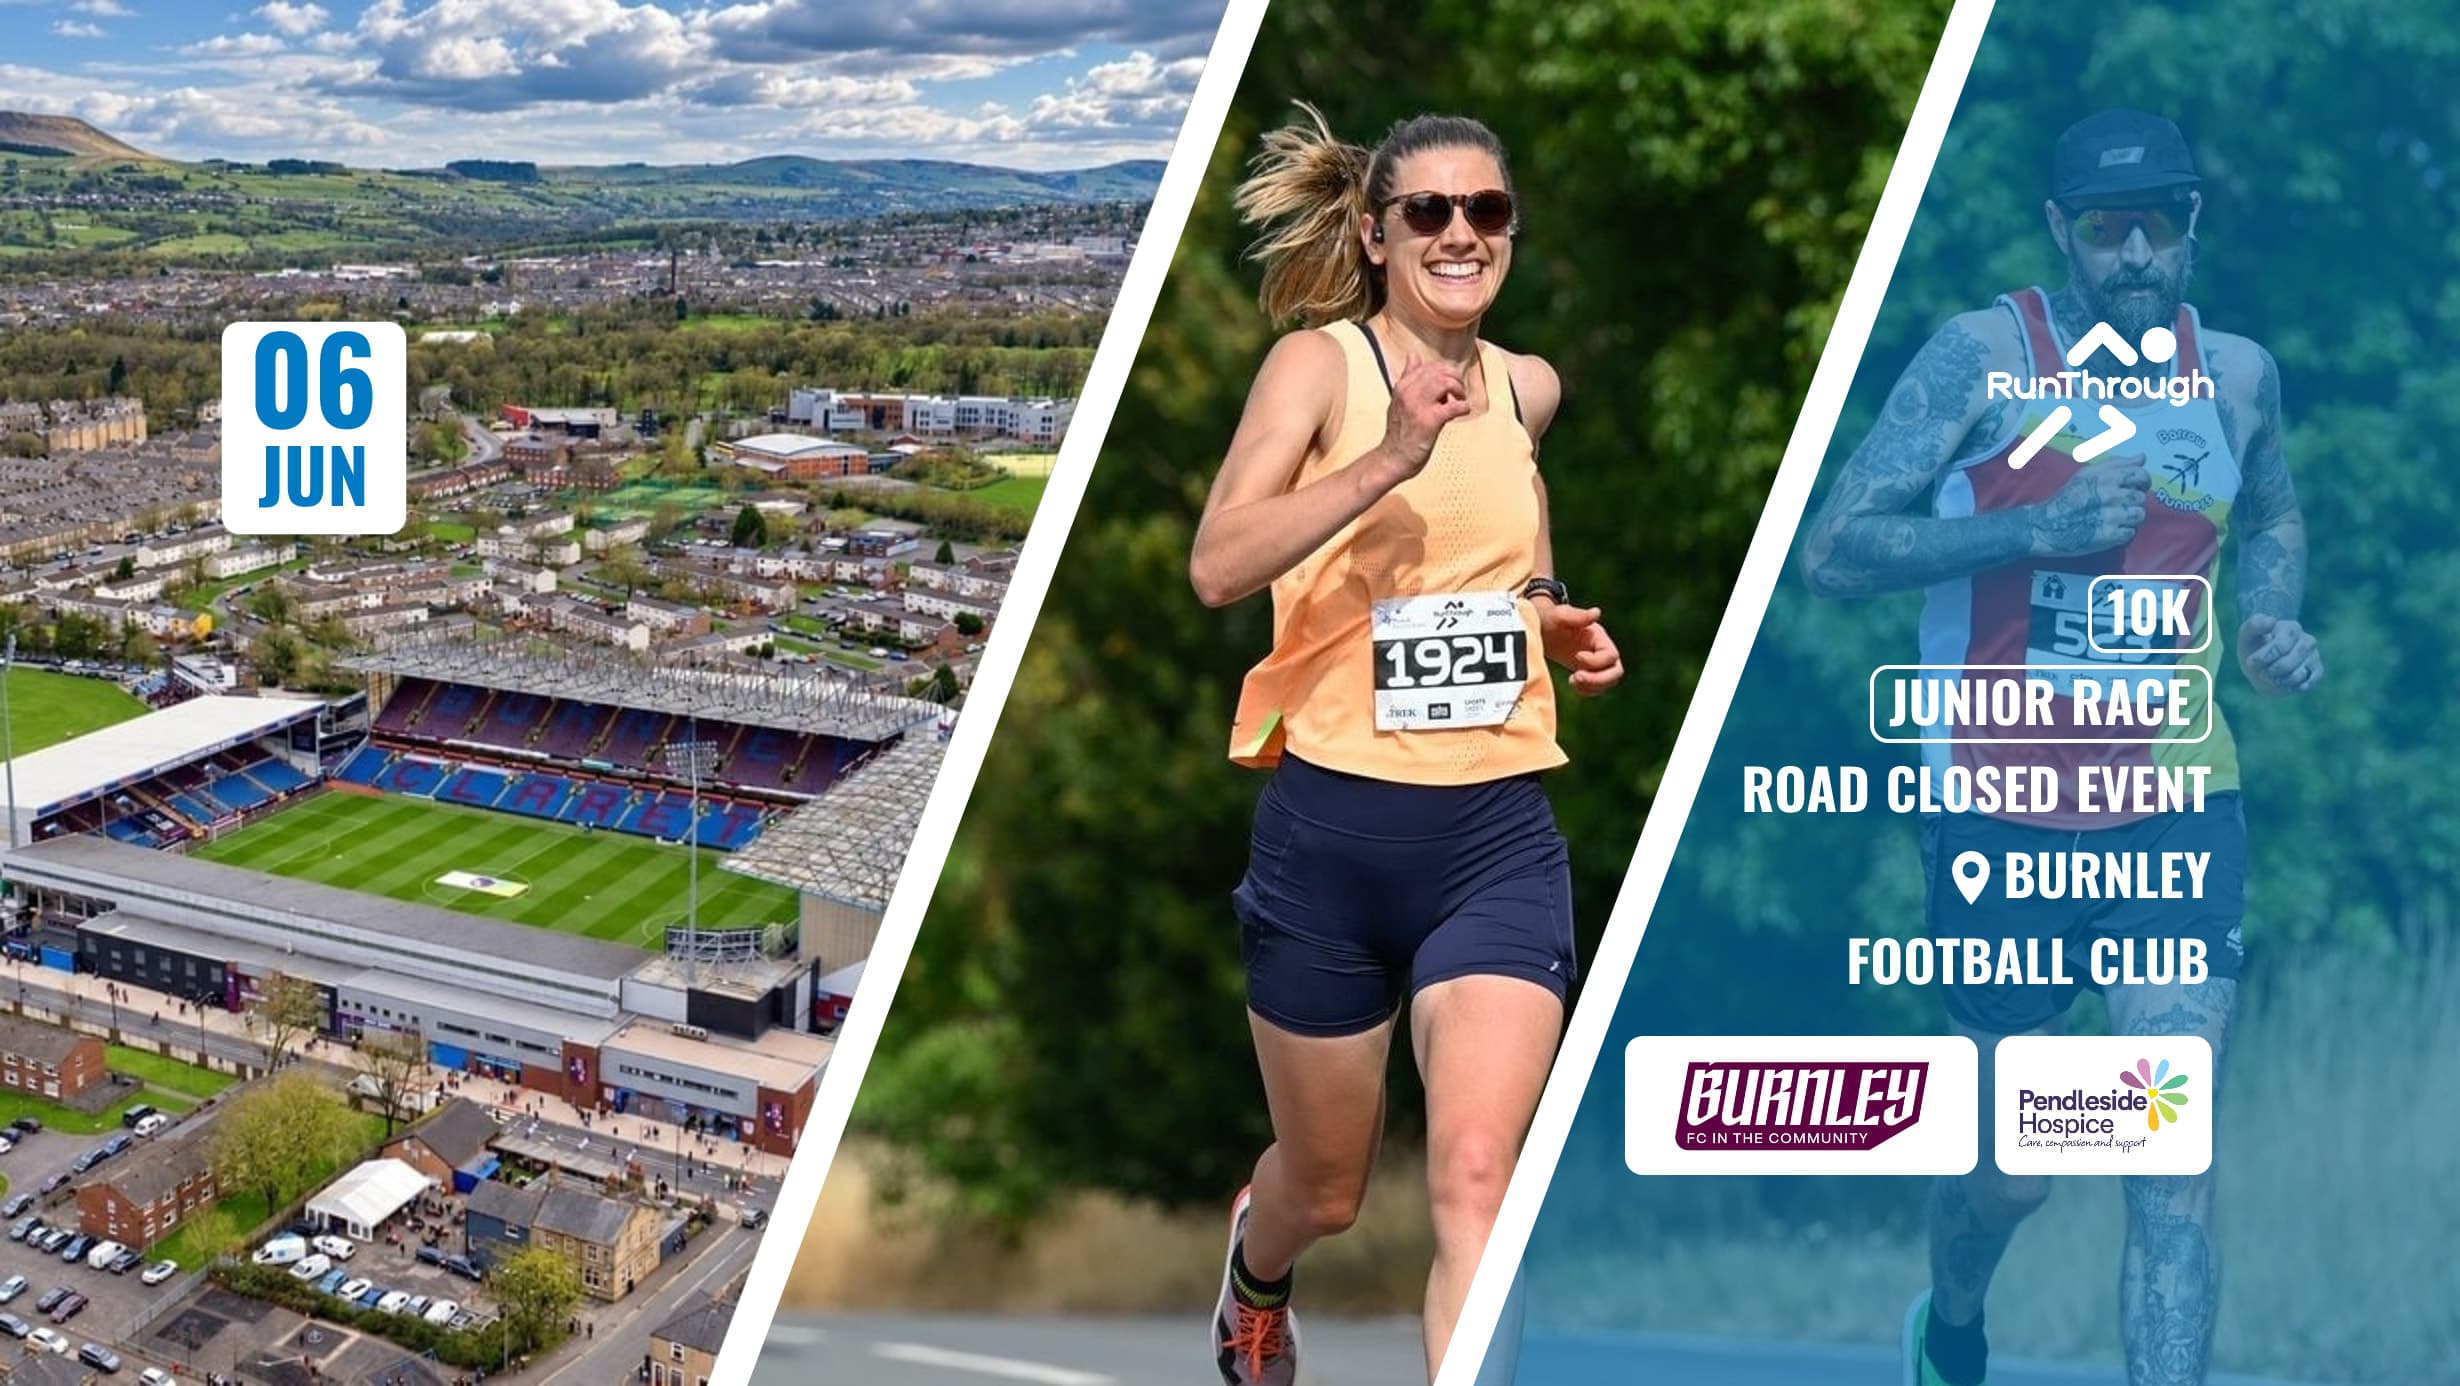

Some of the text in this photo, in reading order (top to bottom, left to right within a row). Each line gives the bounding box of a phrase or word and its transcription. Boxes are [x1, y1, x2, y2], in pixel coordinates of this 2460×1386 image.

[2156, 428, 2206, 449] Barrow
[2156, 488, 2214, 512] Runners
[1386, 633, 1516, 688] 1924
